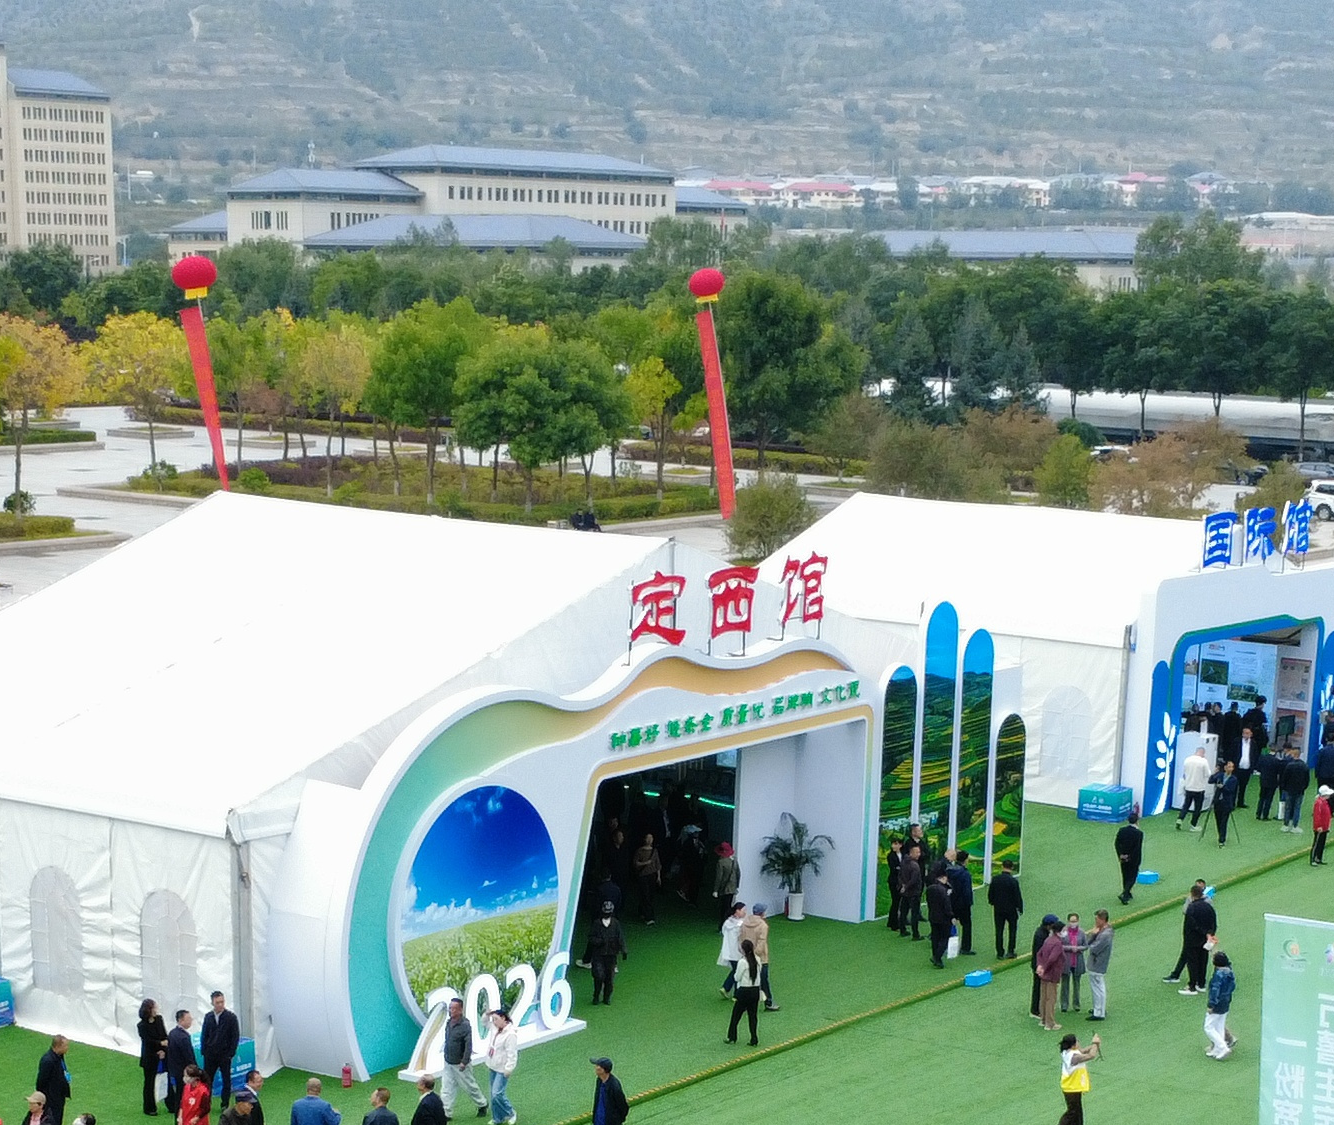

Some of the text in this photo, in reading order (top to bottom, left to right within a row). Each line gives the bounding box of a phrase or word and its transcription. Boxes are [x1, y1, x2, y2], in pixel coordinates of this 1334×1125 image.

[1202, 499, 1314, 568] 国际馆
[629, 551, 828, 645] 定西馆
[409, 951, 572, 1072] 2026
